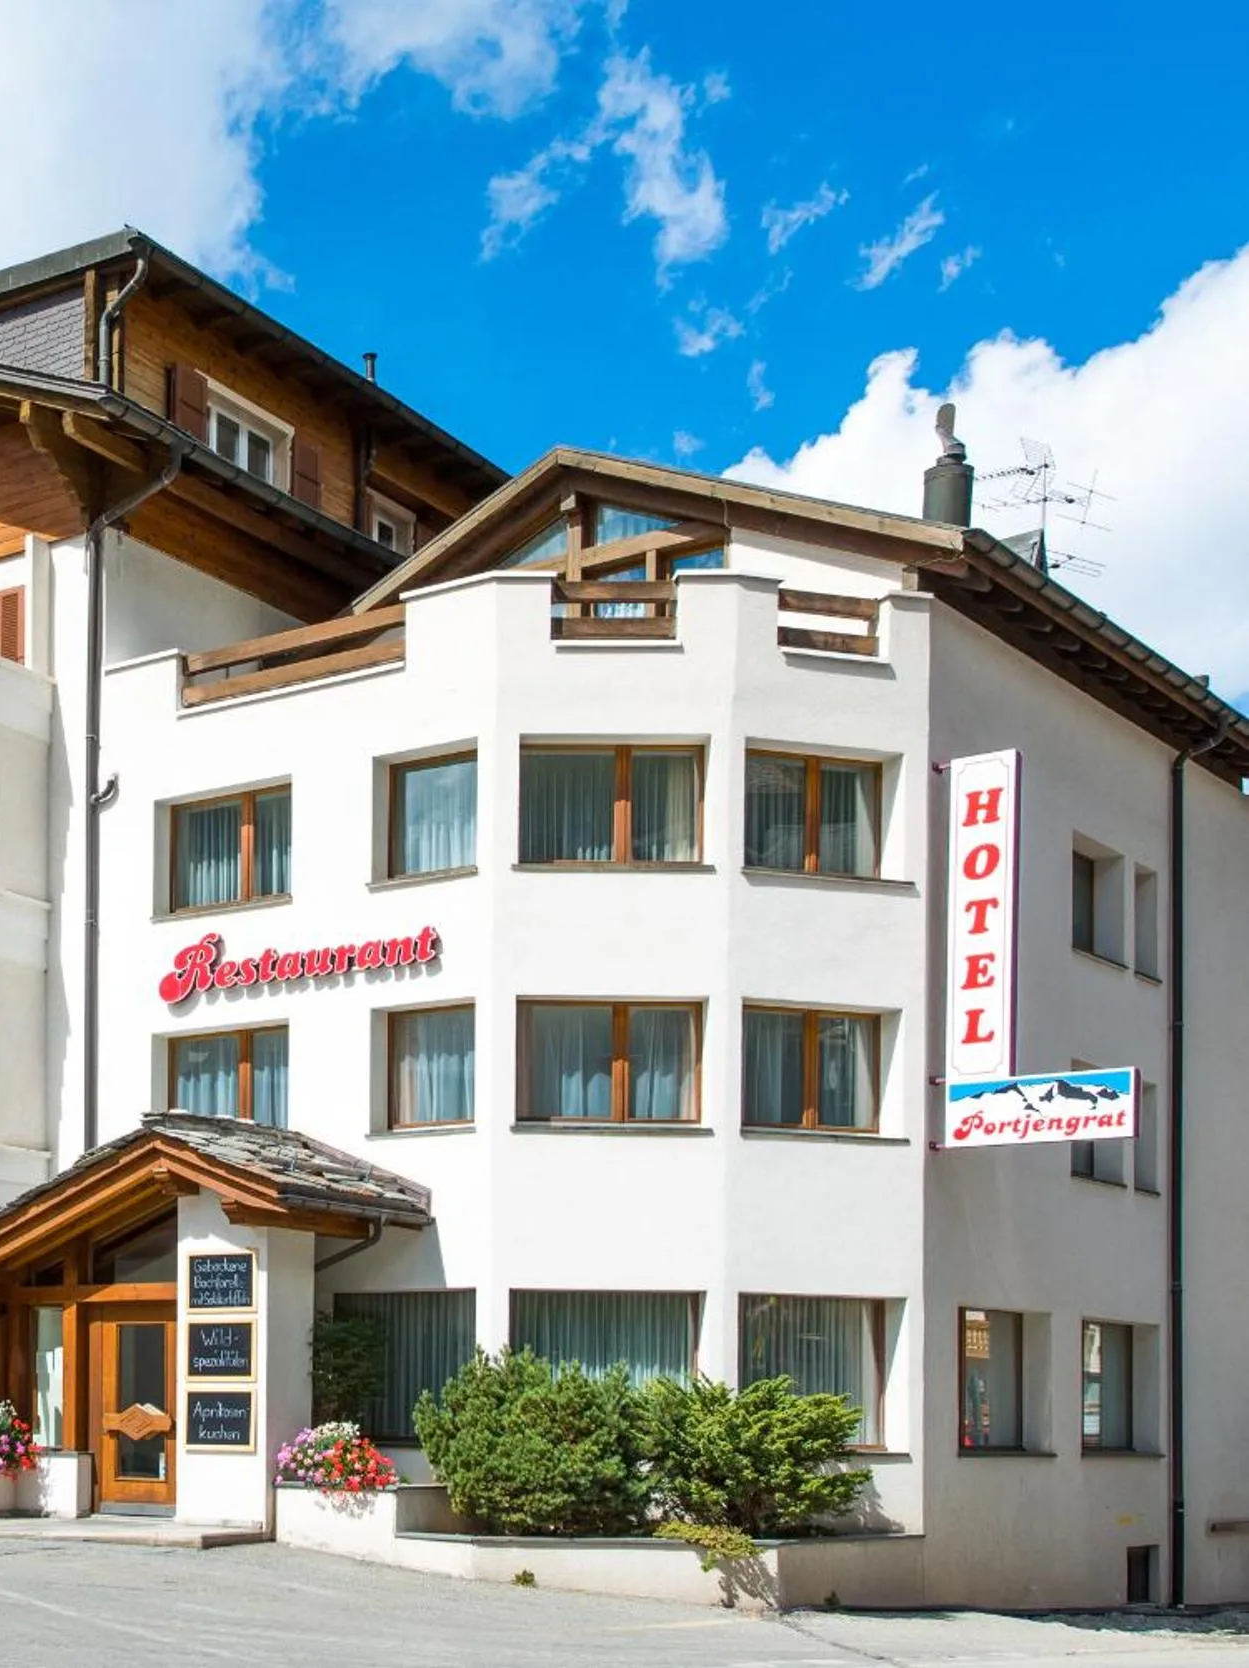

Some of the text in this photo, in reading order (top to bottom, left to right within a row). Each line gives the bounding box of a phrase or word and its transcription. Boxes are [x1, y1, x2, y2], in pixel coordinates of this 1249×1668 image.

[961, 787, 1004, 1045] HOTEL
[159, 926, 442, 1003] Restaurant
[953, 1110, 1126, 1140] Portjengrat
